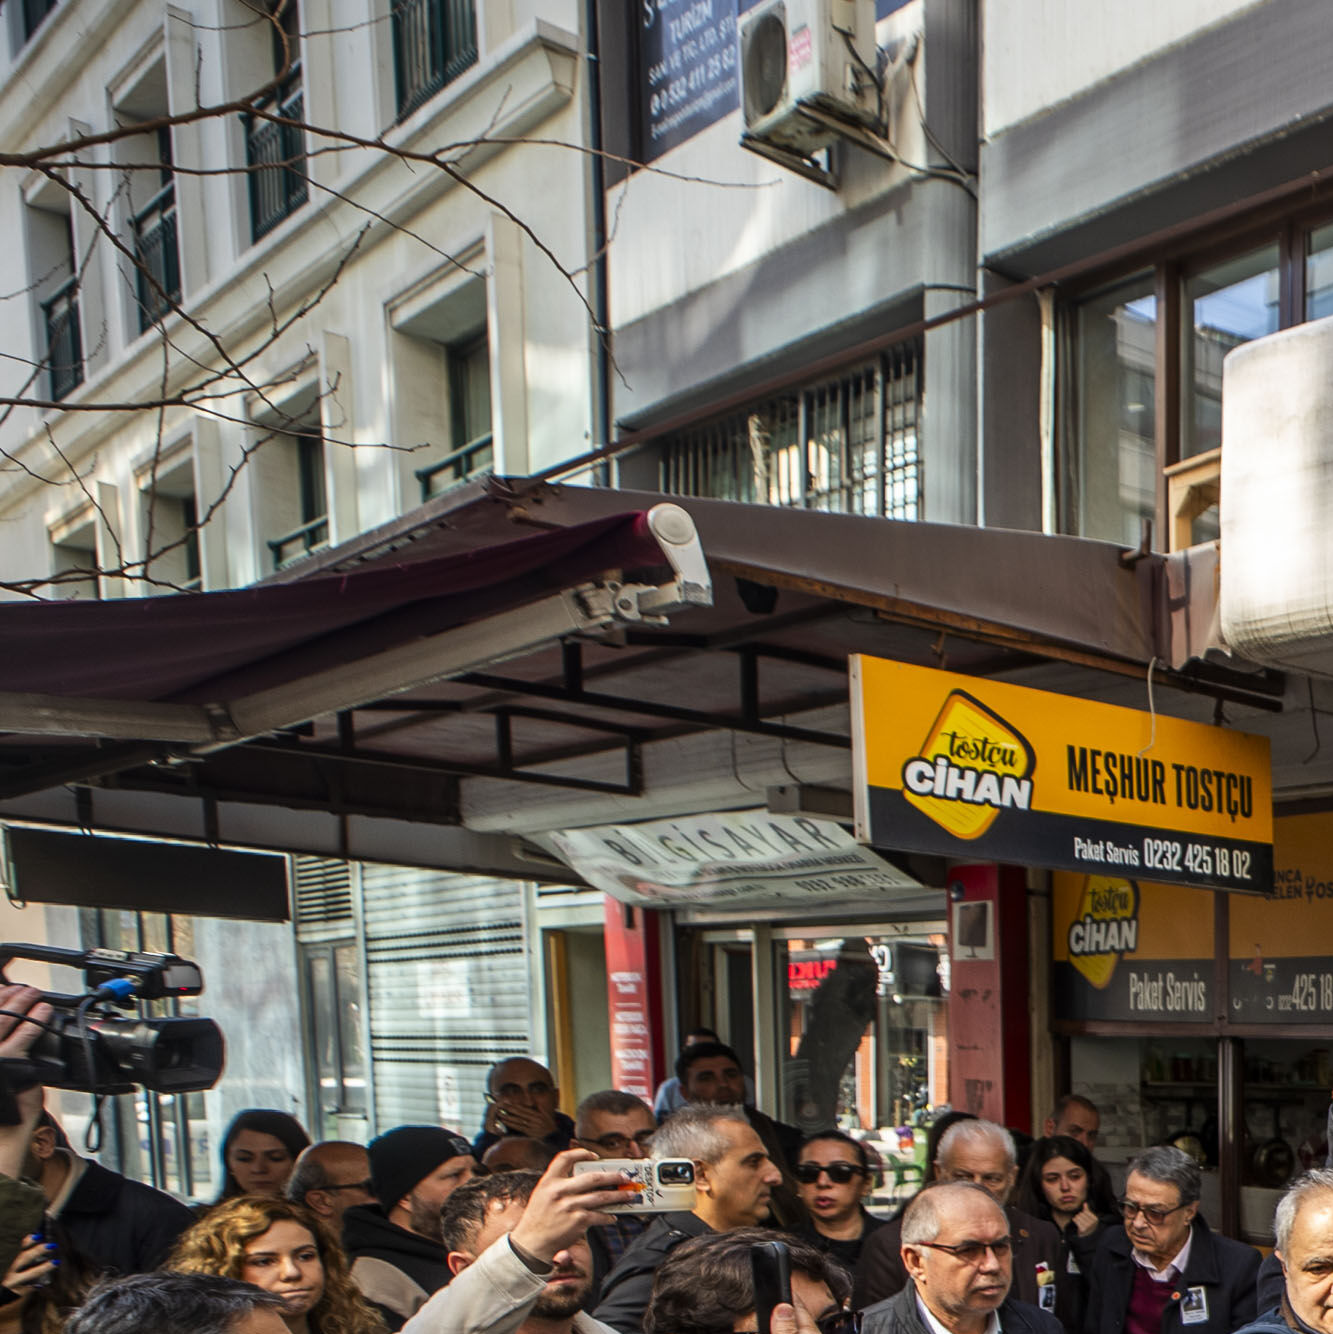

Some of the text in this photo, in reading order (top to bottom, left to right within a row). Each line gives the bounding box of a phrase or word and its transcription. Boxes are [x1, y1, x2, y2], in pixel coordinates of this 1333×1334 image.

[940, 731, 1017, 767] tostçu
[904, 756, 1032, 811] CİHAN
[1066, 744, 1253, 823] MEŞHUR TOSTÇU
[603, 816, 842, 866] BİLGİSAYAR
[1074, 836, 1252, 879] Paket Servis 0232 425 18 02
[1266, 885, 1302, 899] ELEN
[1069, 916, 1137, 953] CİHAN
[1129, 973, 1164, 1011] Paket
[1166, 973, 1206, 1011] Servis
[1291, 974, 1317, 1011] 425
[1320, 974, 1333, 1011] 18
